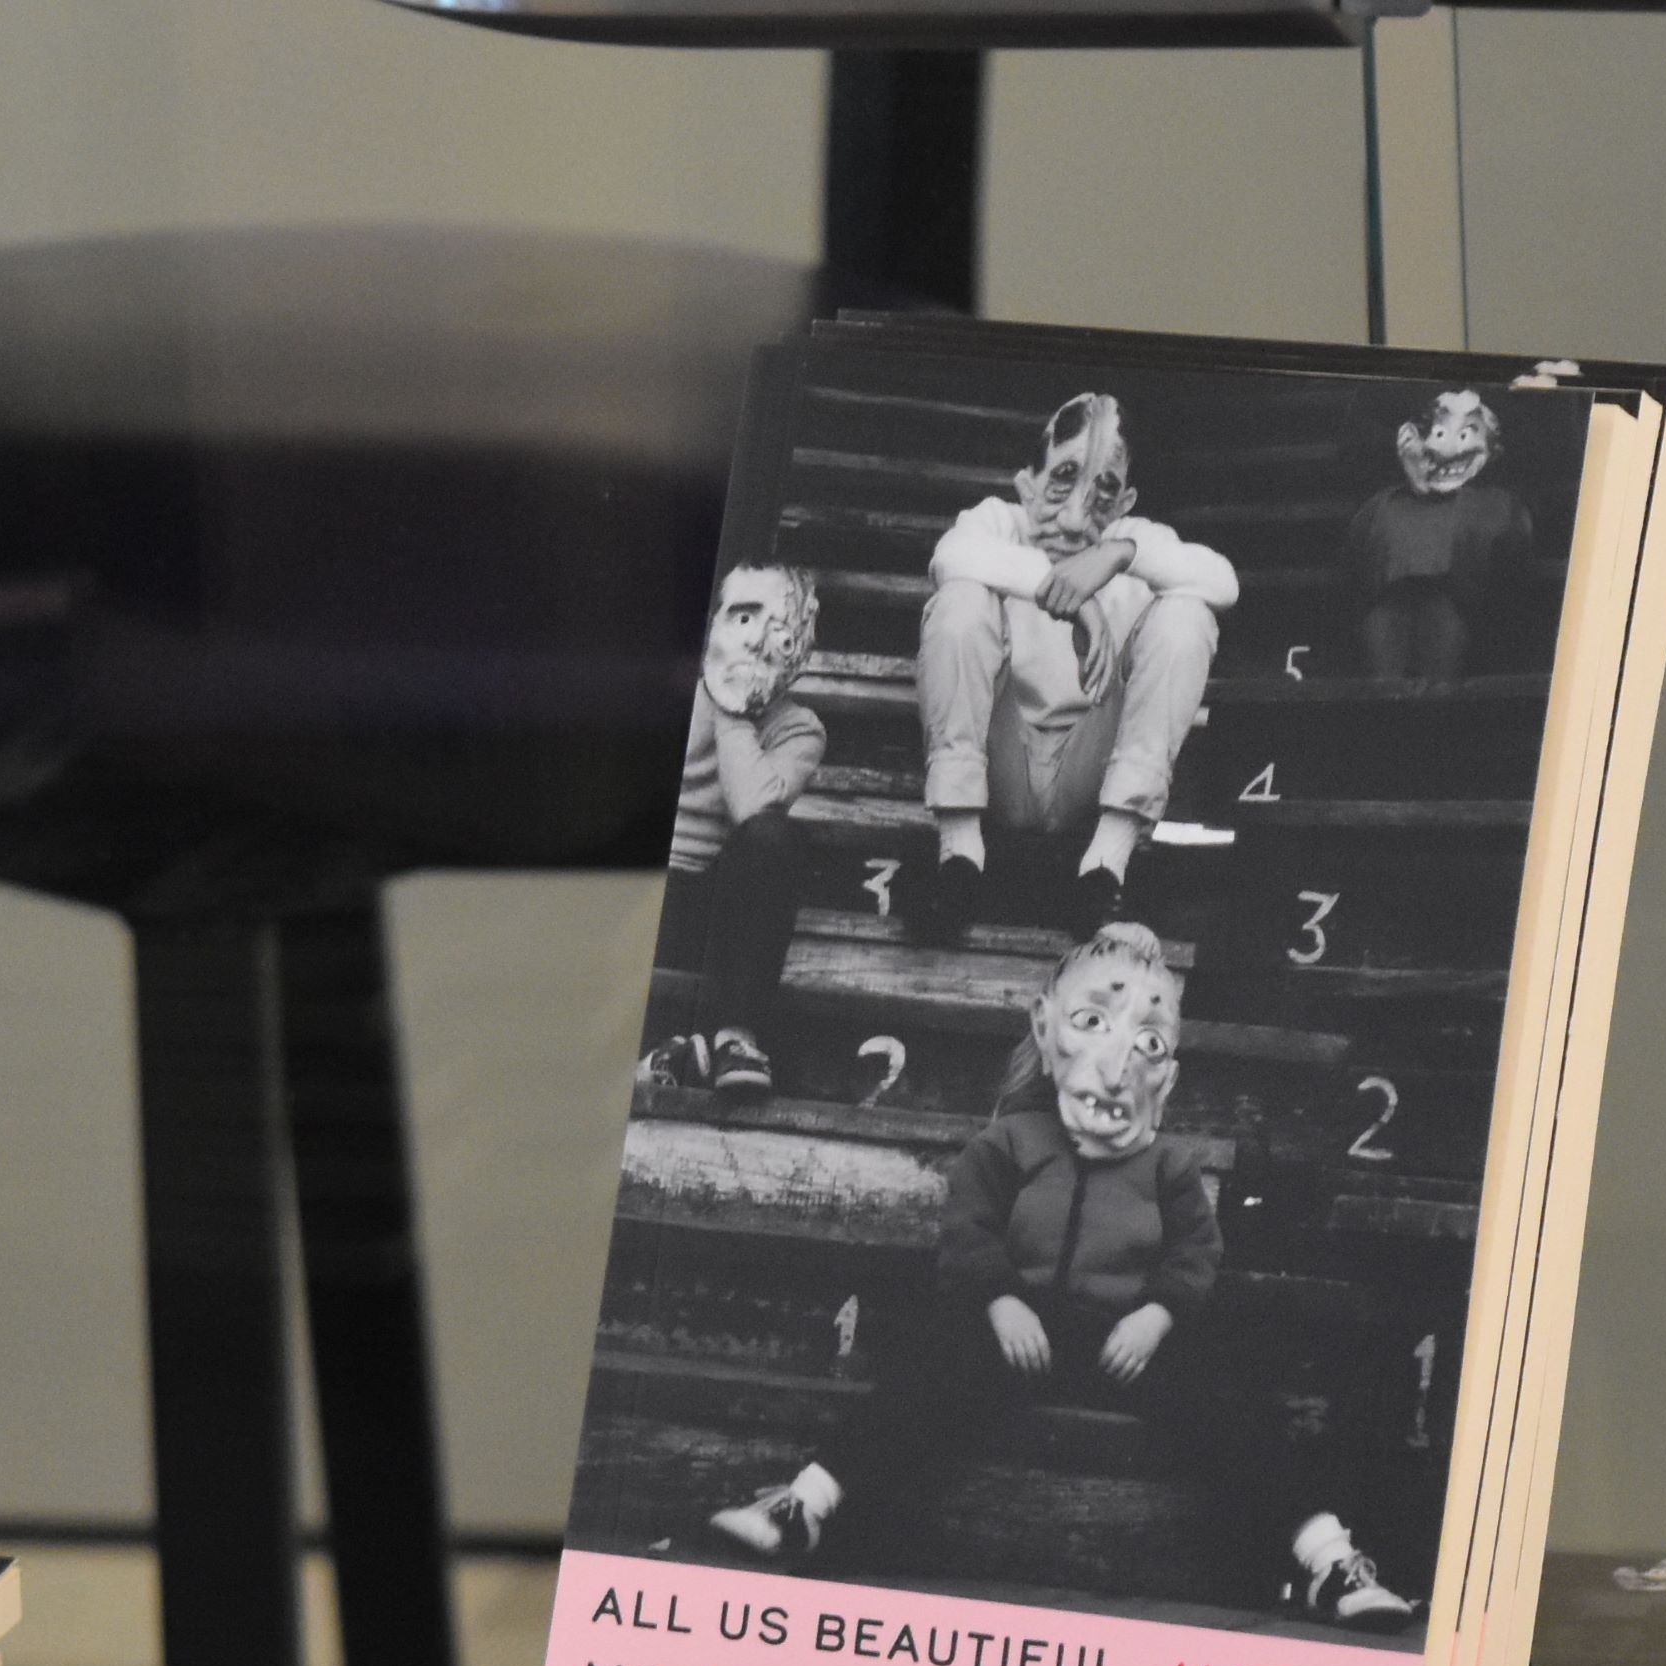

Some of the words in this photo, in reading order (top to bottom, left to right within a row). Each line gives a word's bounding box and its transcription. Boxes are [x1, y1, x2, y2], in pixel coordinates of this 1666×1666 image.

[1287, 890, 1340, 965] 3
[1346, 1076, 1399, 1161] 2
[591, 1587, 692, 1634] ALL
[719, 1604, 789, 1646] US
